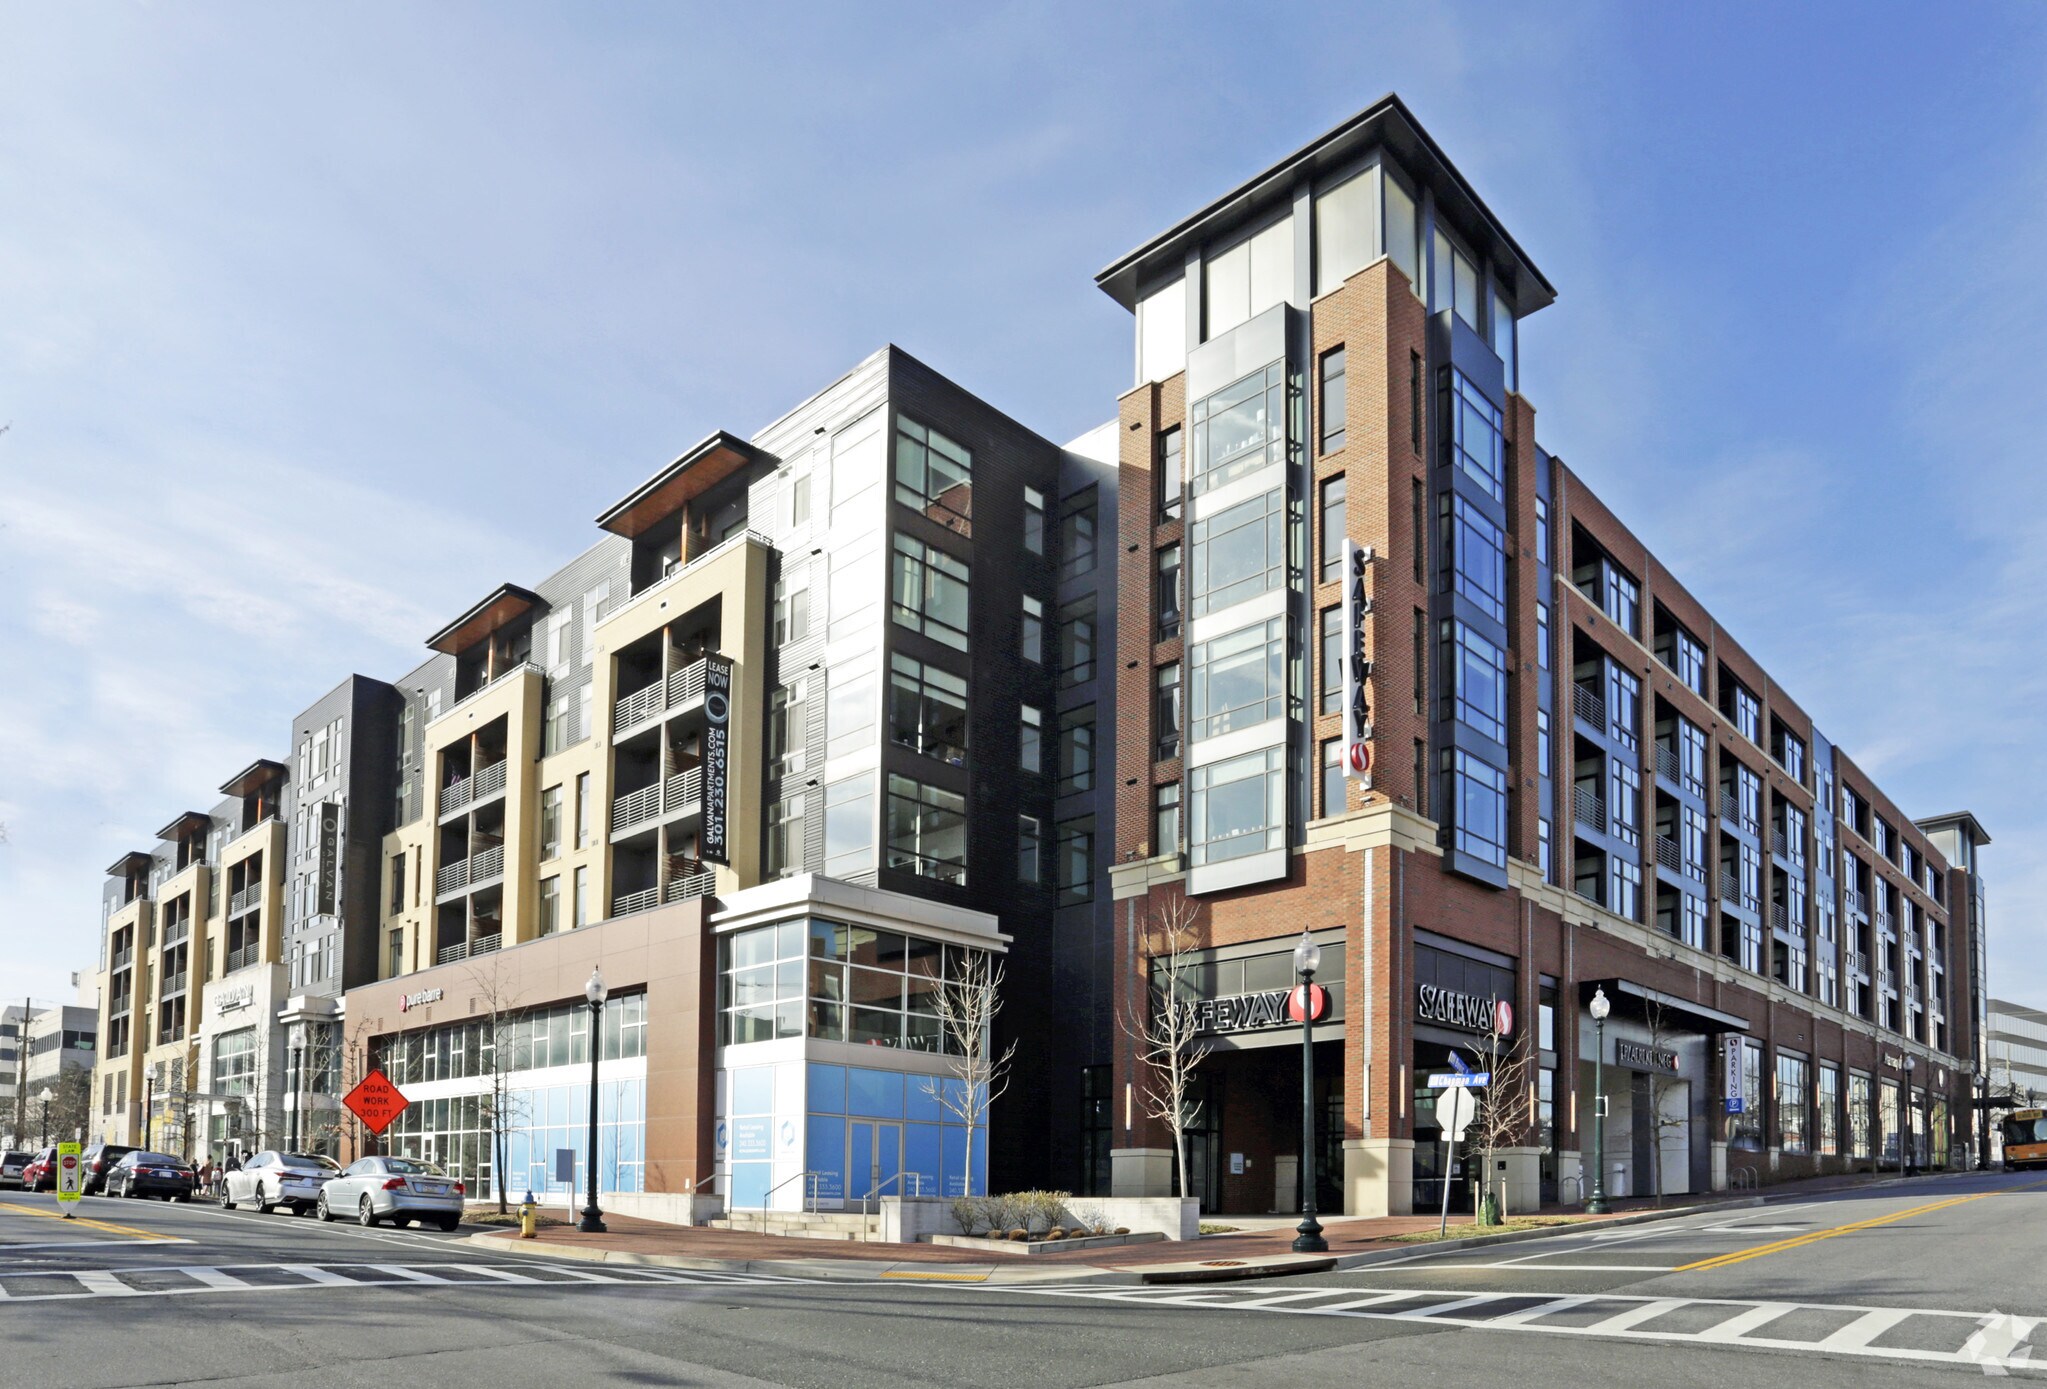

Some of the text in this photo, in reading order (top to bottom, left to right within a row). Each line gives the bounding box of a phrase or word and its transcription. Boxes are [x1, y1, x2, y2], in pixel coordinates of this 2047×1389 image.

[708, 660, 729, 676] LEASE
[707, 672, 728, 689] NOW
[706, 726, 717, 845] GALVANAPARTMENTS.COM
[714, 728, 726, 847] 301.230.6515
[325, 837, 335, 901] GALVAN
[1420, 984, 1496, 1031] SAFEWAY
[1620, 1043, 1672, 1068] PARKING
[1438, 1075, 1470, 1087] Chapman
[1472, 1075, 1487, 1085] Ave
[1730, 1047, 1738, 1098] PARKING
[363, 1084, 389, 1094] ROAD
[363, 1096, 390, 1105] WORK
[360, 1108, 393, 1118] 300 FT
